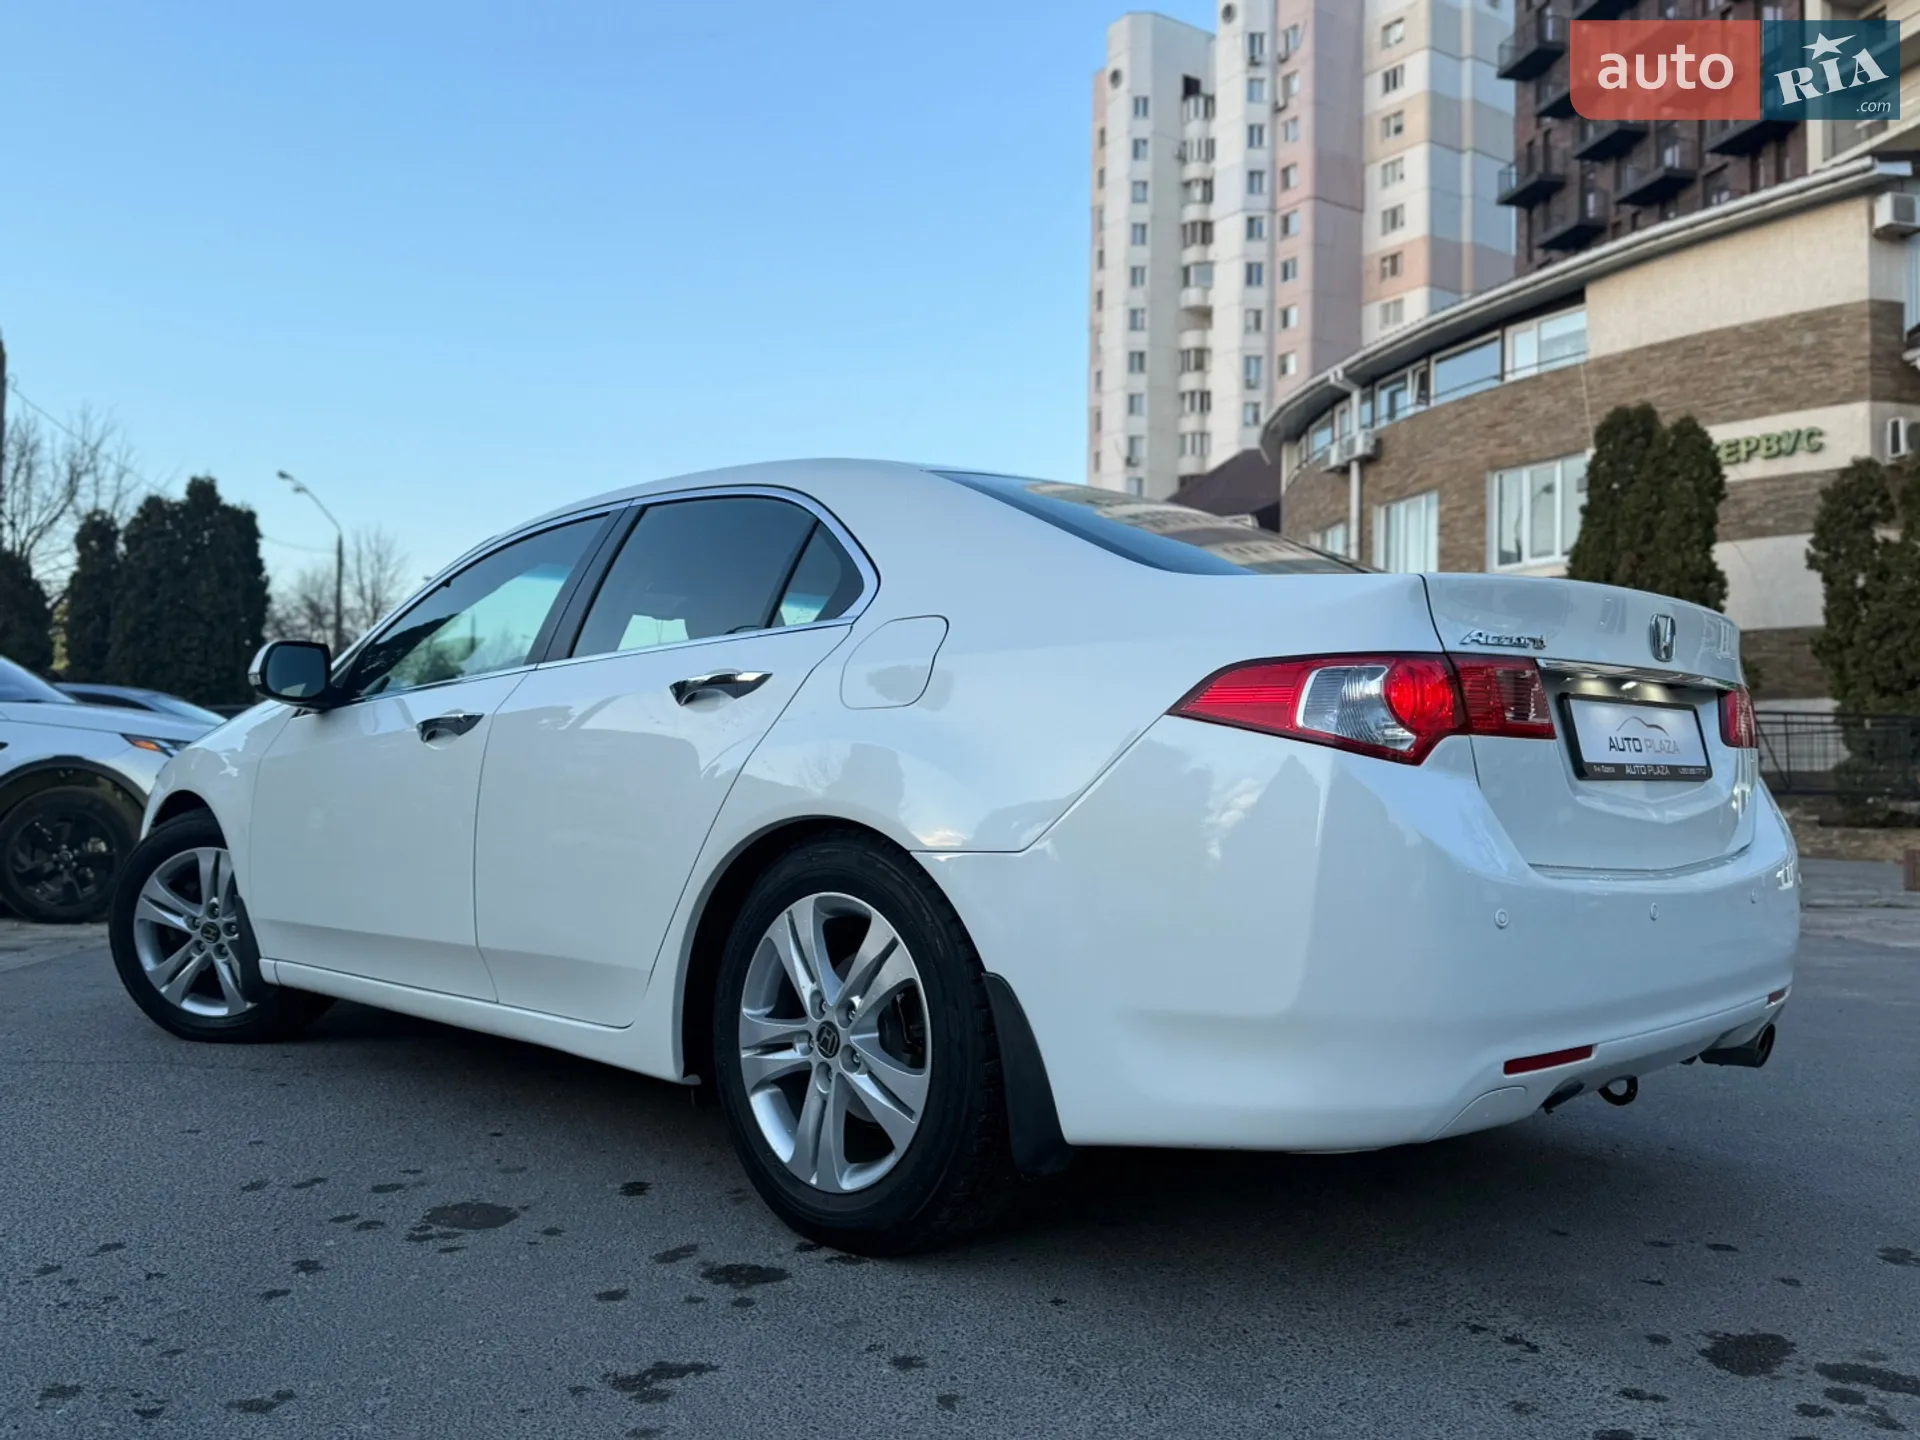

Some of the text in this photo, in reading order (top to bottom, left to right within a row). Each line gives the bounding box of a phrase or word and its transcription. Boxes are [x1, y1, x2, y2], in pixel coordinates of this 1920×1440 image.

[1713, 426, 1825, 467] ЕРВУС
[1608, 736, 1680, 754] AUTO PLAZA
[1625, 765, 1648, 775] AUTO
[1647, 766, 1671, 776] PLAZA
